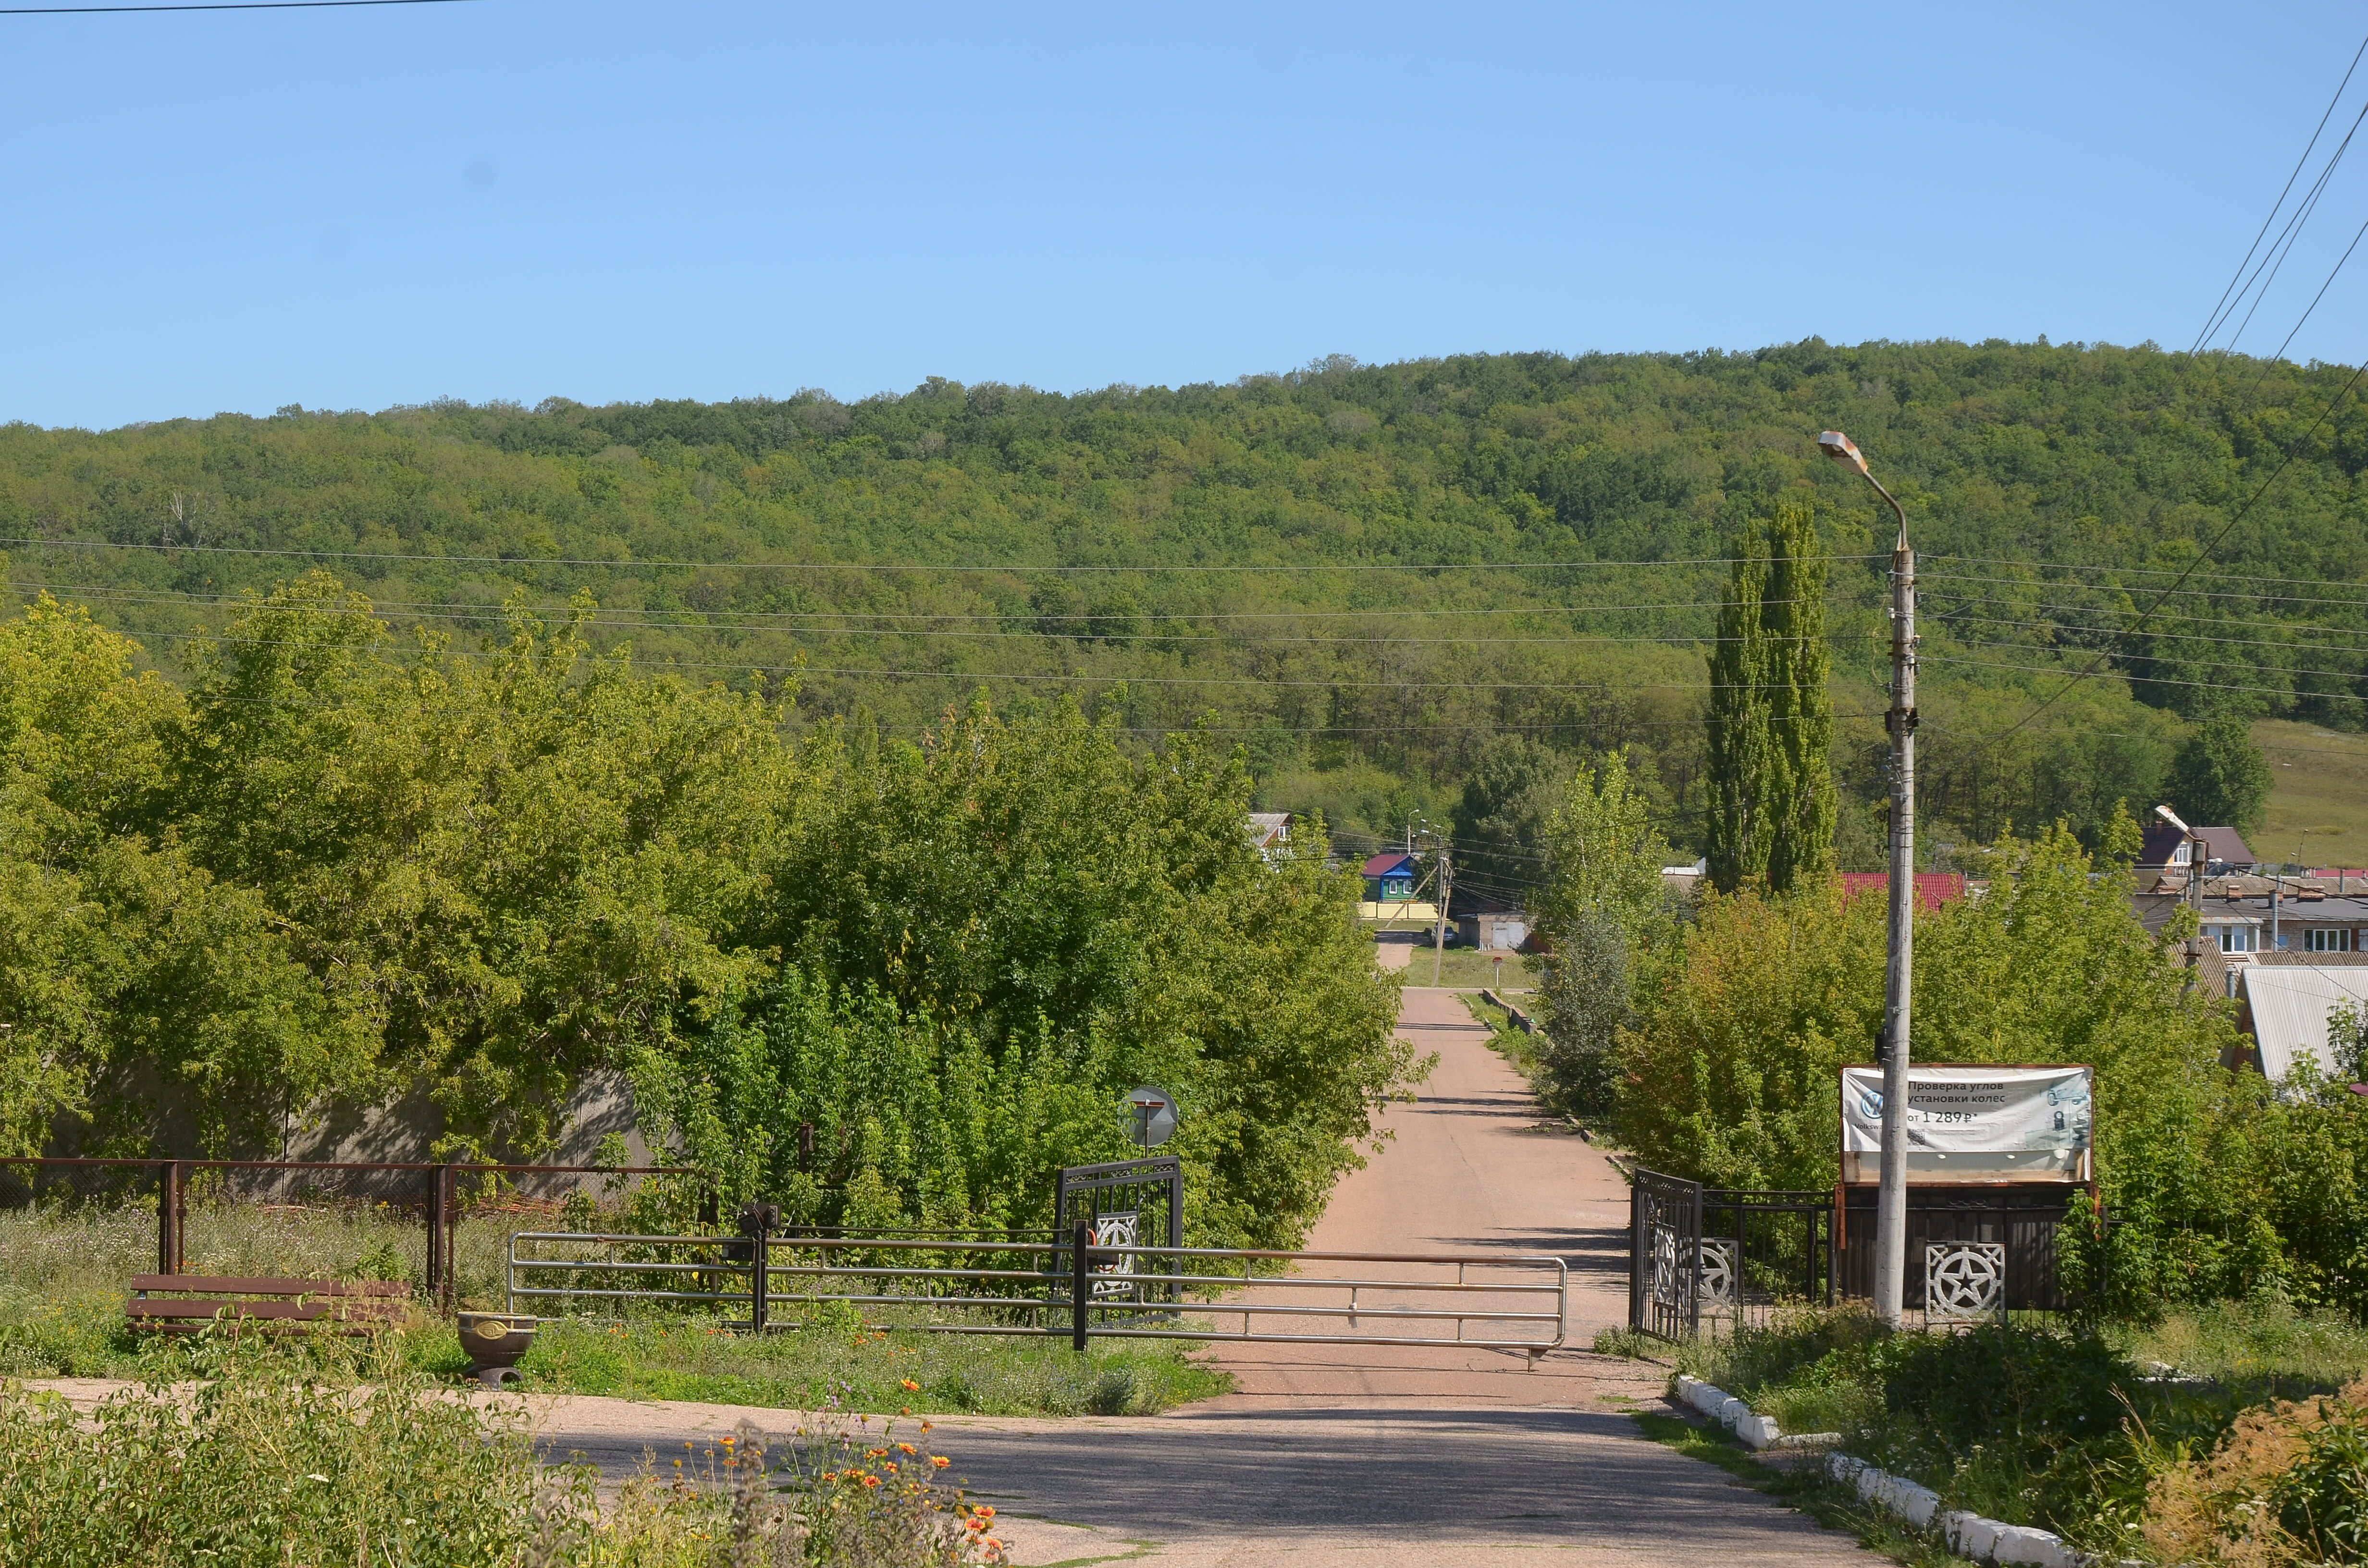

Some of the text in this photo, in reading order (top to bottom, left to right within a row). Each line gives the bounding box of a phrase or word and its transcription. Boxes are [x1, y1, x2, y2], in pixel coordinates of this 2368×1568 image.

[1908, 1081, 2004, 1092] Проверка углов
[1908, 1095, 2005, 1104] установки колес
